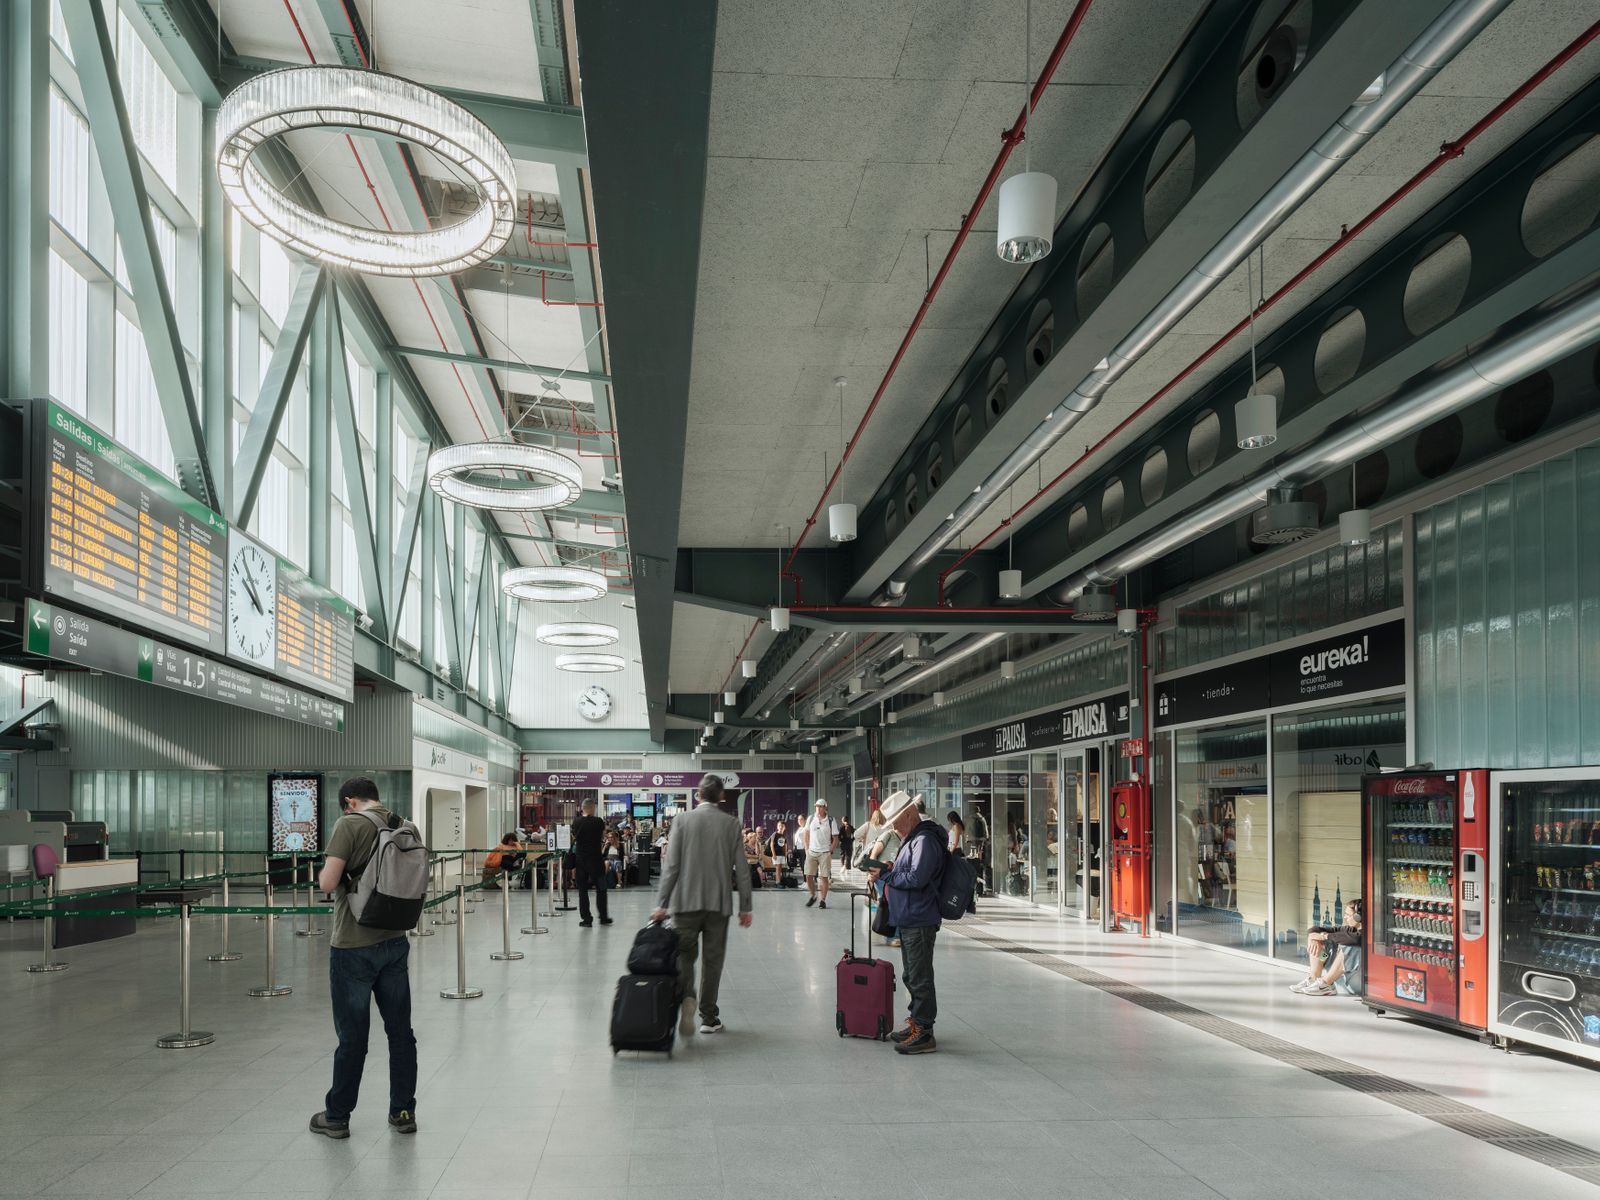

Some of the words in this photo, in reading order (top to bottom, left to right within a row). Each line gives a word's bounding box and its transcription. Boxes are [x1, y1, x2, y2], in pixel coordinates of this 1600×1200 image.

[56, 413, 92, 446] Salidas
[52, 461, 73, 482] 10:24
[52, 477, 73, 497] 10:37
[51, 507, 72, 527] 10:57
[69, 616, 90, 632] Salida
[1300, 635, 1369, 676] eureka!
[183, 657, 193, 687] 1
[192, 679, 197, 688] a
[197, 661, 206, 689] 5
[1300, 674, 1327, 686] encuentra
[1206, 683, 1231, 700] tienda
[1306, 684, 1316, 695] que
[1316, 679, 1343, 691] necesitas
[1063, 715, 1072, 735] LA
[1072, 702, 1108, 739] PAUSA
[996, 732, 1002, 748] LA
[1002, 722, 1027, 751] PAUSA
[763, 809, 797, 823] renfe
[549, 838, 554, 848] B
